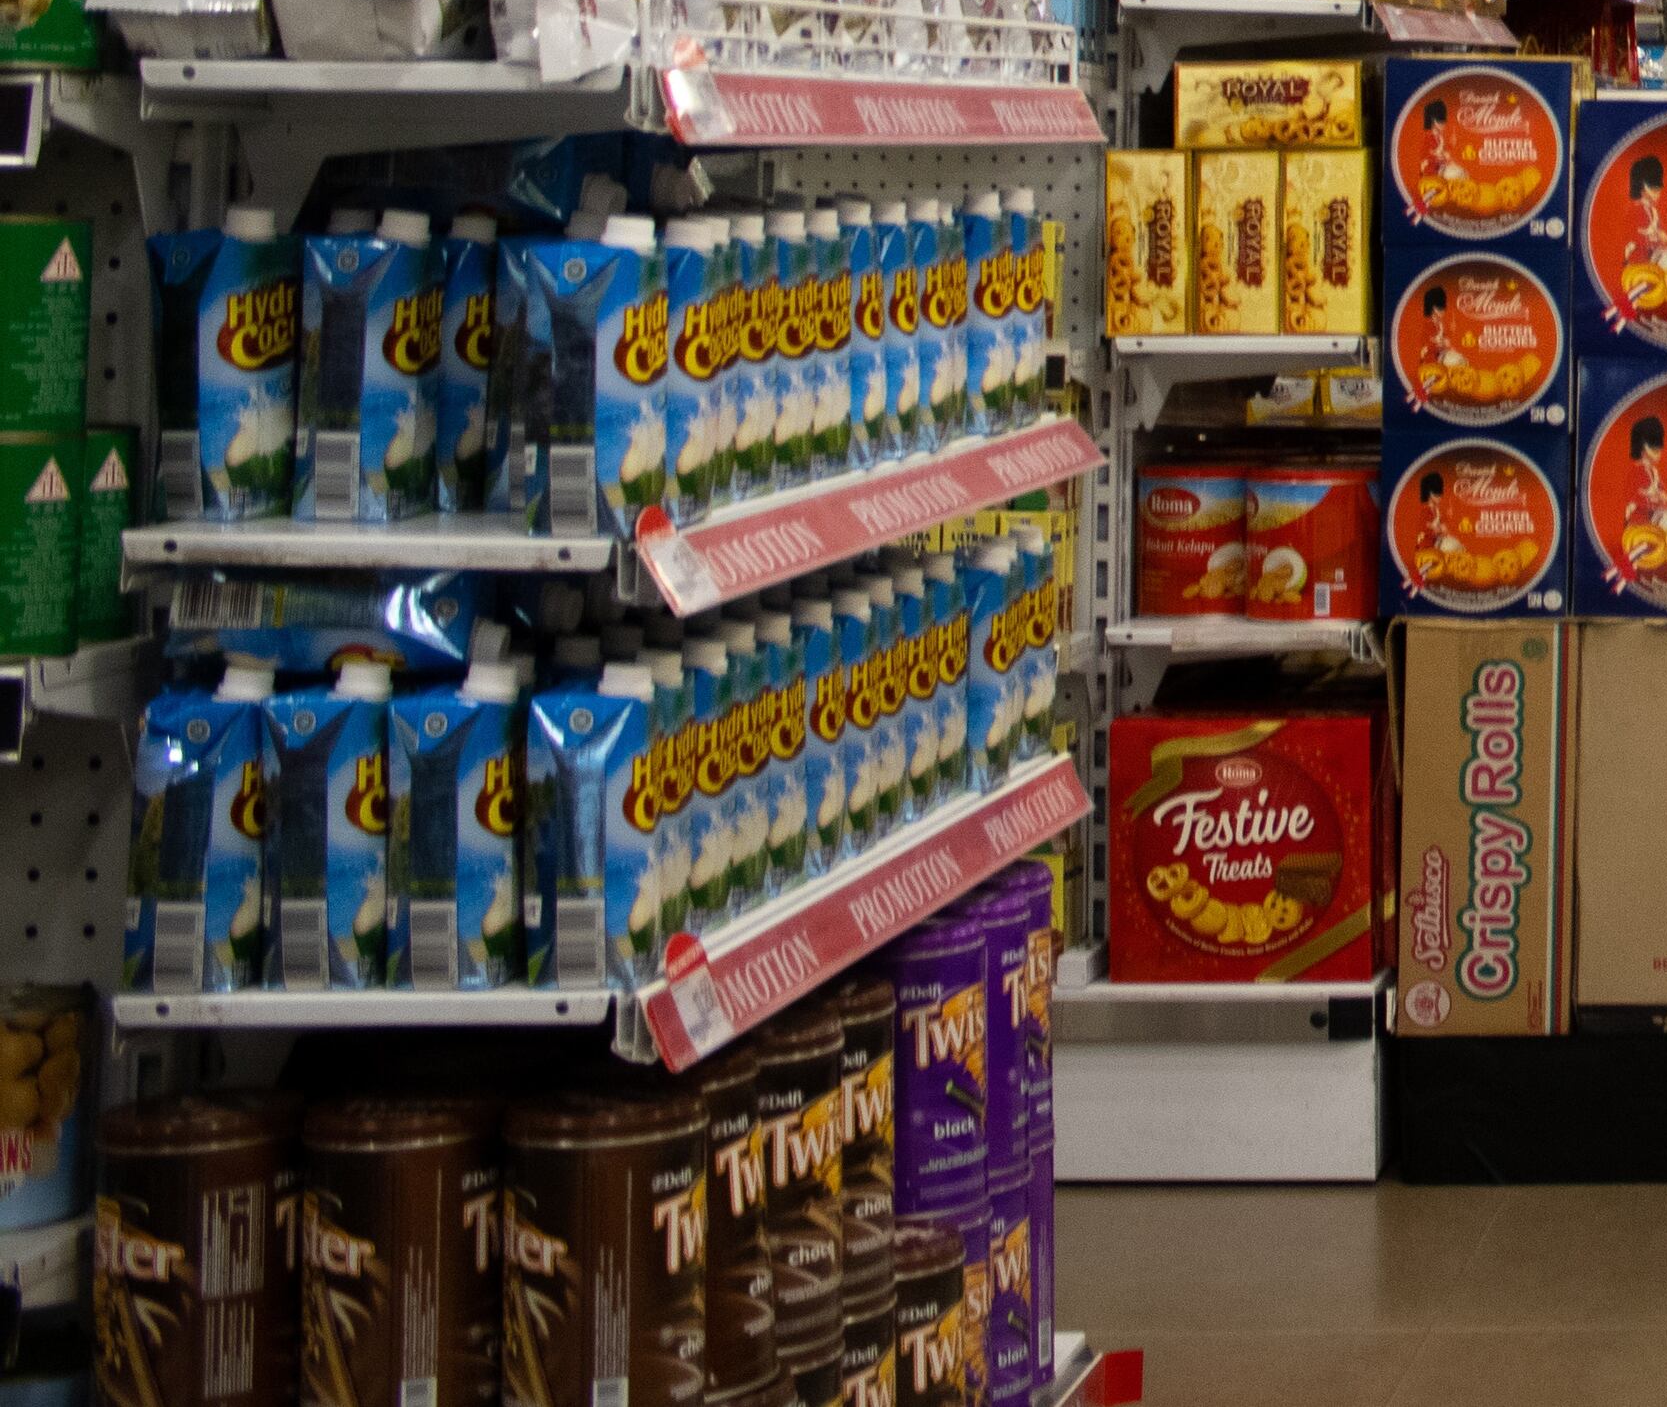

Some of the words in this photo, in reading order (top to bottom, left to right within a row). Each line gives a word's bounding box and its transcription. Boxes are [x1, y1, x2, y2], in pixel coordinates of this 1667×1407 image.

[848, 472, 968, 534] PROMOTION
[1466, 663, 1520, 803] Rolls
[983, 777, 1077, 855] PROMOTION
[1153, 787, 1315, 857] Festive
[849, 847, 964, 942] PROMOTION
[1202, 851, 1273, 885] Treats
[1463, 811, 1528, 998] Crispy
